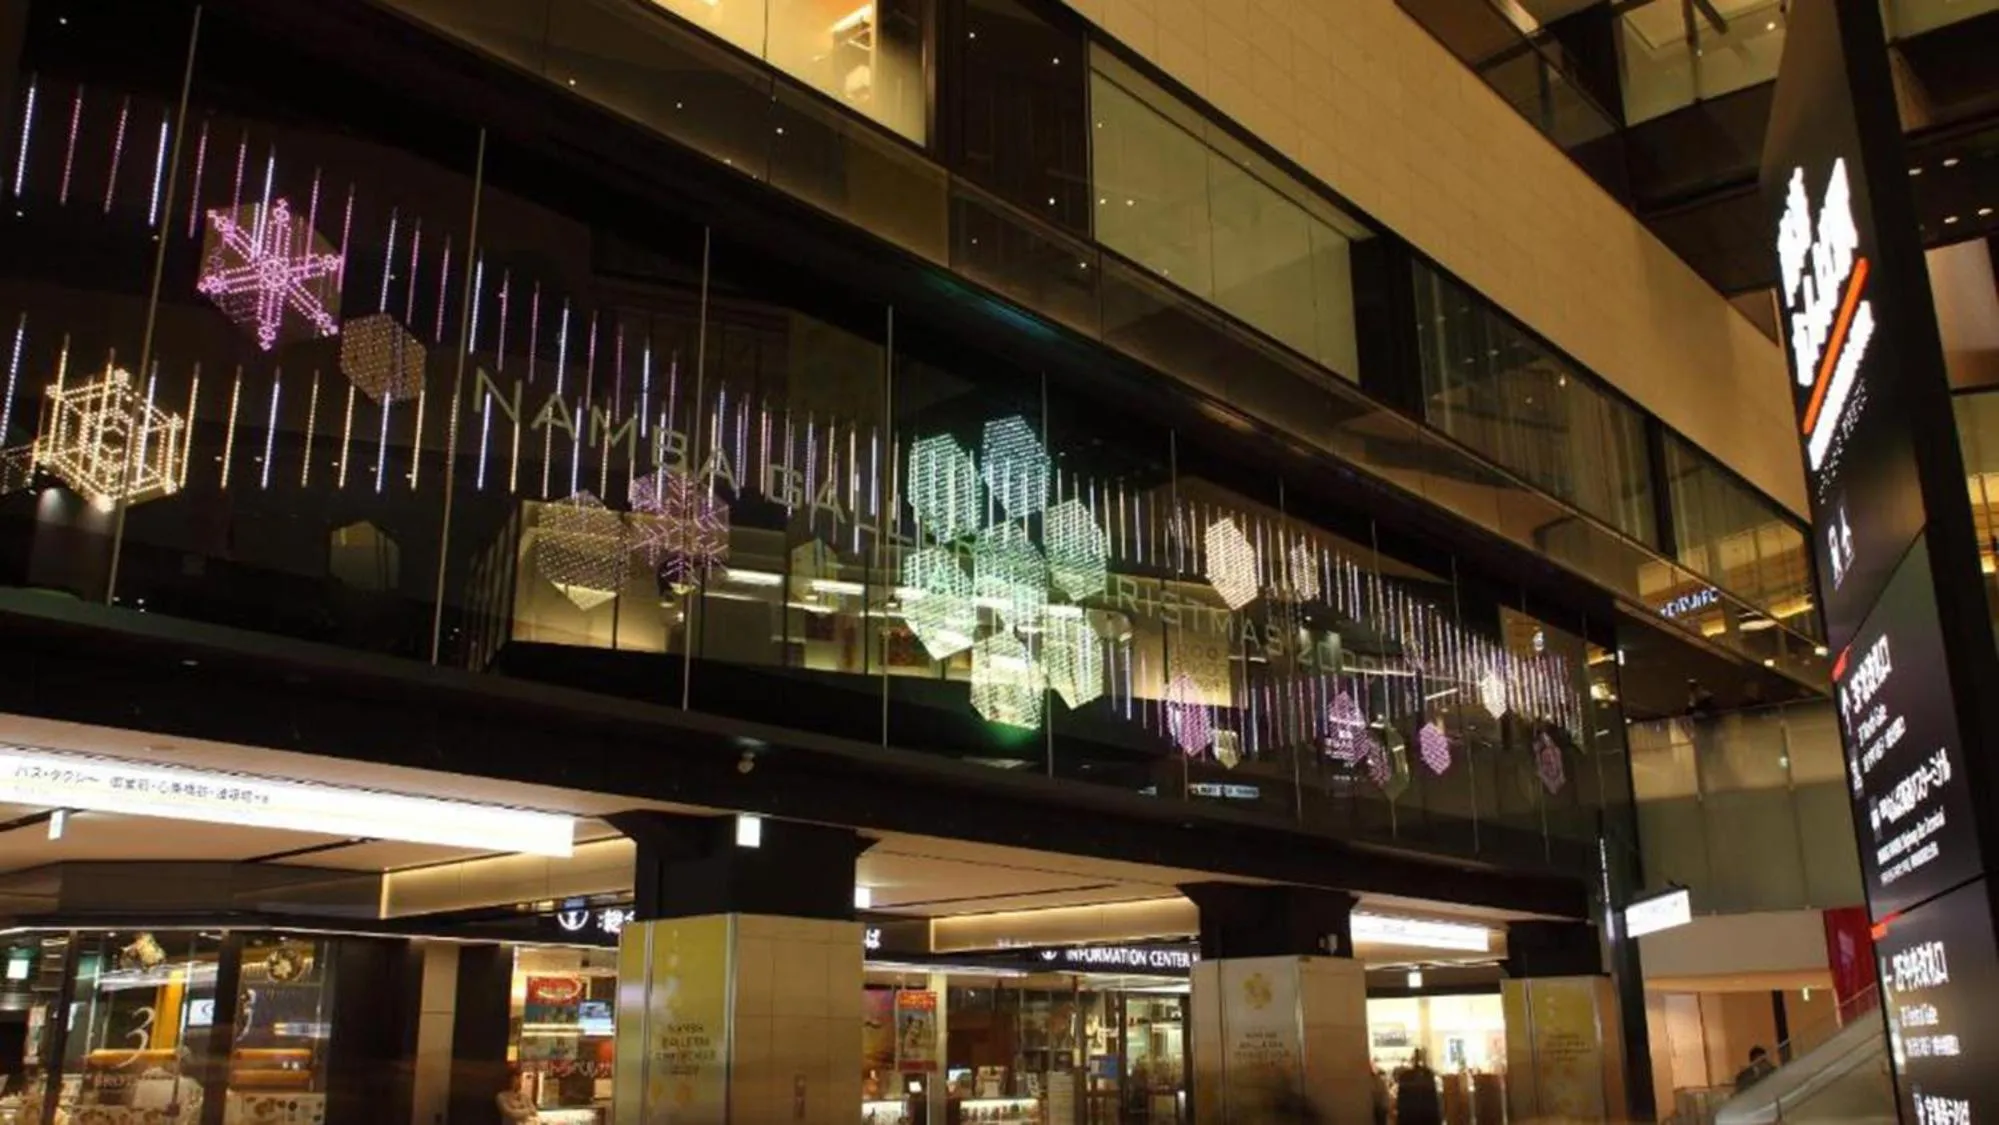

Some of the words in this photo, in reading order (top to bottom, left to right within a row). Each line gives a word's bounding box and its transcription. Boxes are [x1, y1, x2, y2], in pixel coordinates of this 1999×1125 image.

[473, 366, 739, 491] NAMBA
[14, 765, 101, 784] バス・タクシー
[1065, 947, 1148, 967] INFORMATION
[1149, 950, 1191, 968] CENTER
